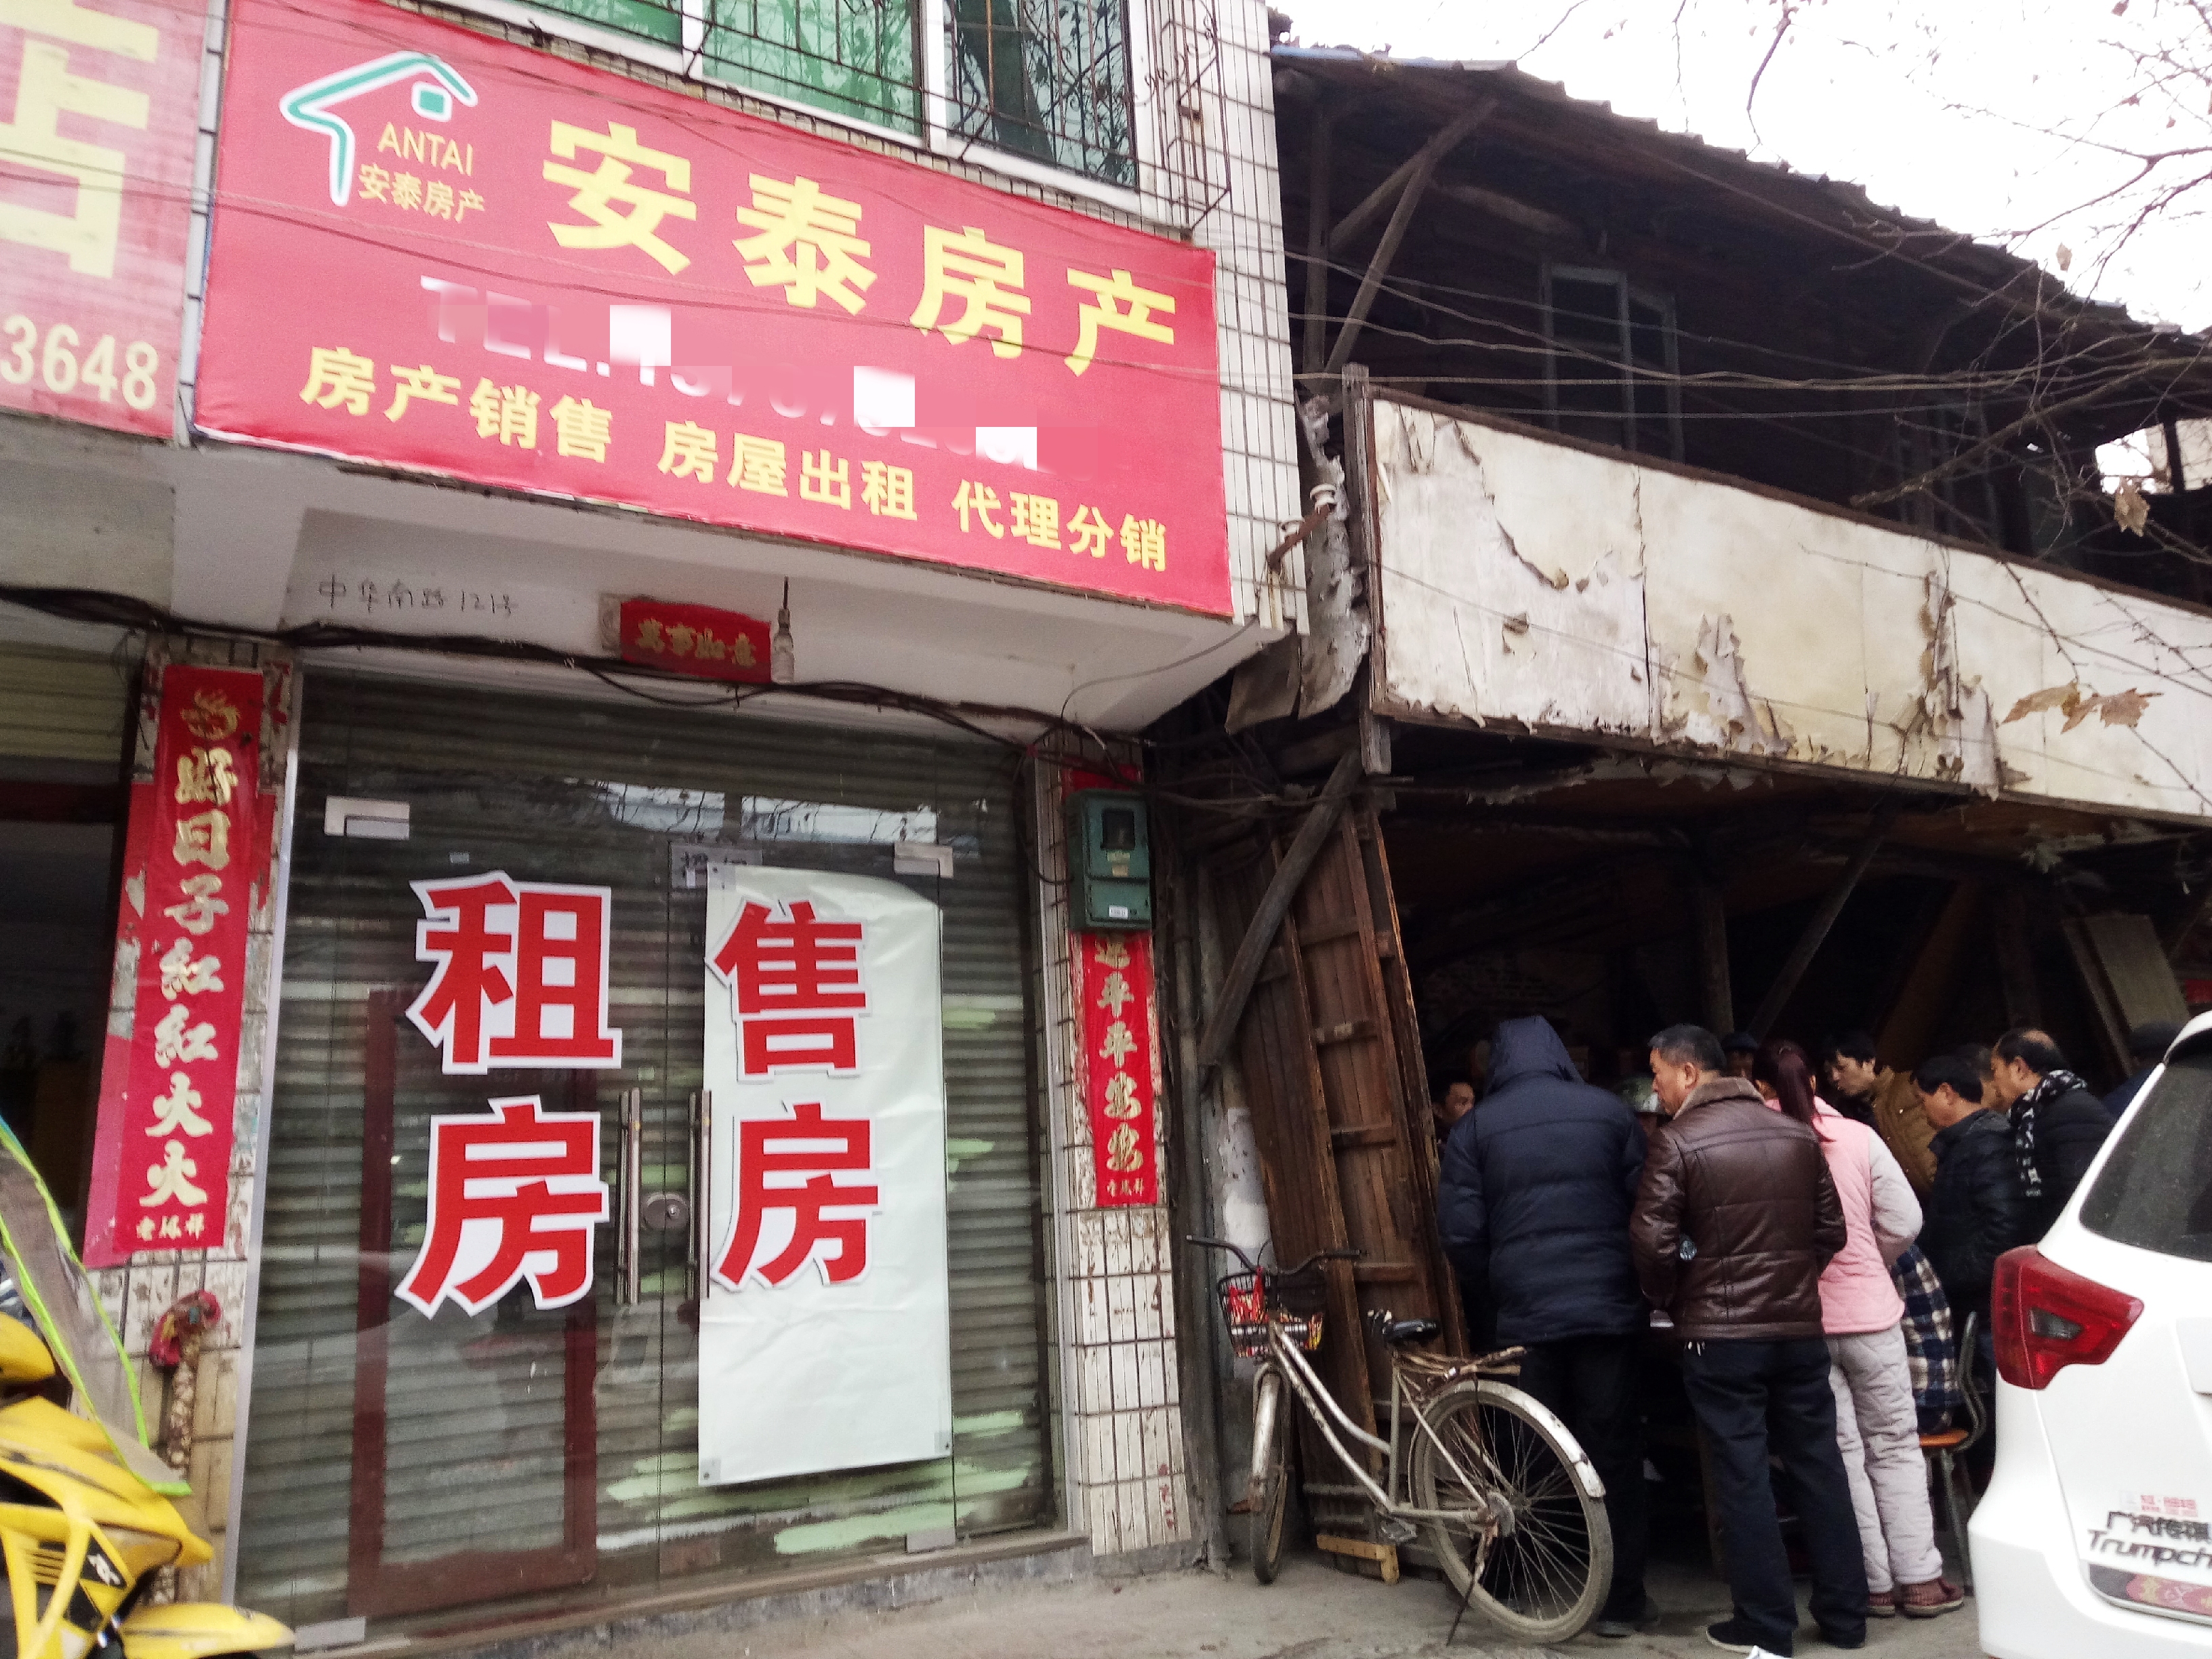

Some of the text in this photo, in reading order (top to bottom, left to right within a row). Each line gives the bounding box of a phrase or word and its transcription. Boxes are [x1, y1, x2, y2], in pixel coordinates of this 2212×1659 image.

[357, 163, 486, 224] 安泰房产
[377, 121, 474, 176] ANTAI
[541, 119, 1176, 377] 安泰房产
[1, 314, 159, 411] 3648
[299, 346, 613, 464] 房产销售
[657, 419, 918, 522] 房屋出租
[951, 478, 1167, 573] 代理分销
[403, 874, 619, 1313] 租房
[712, 899, 881, 1289] 售房
